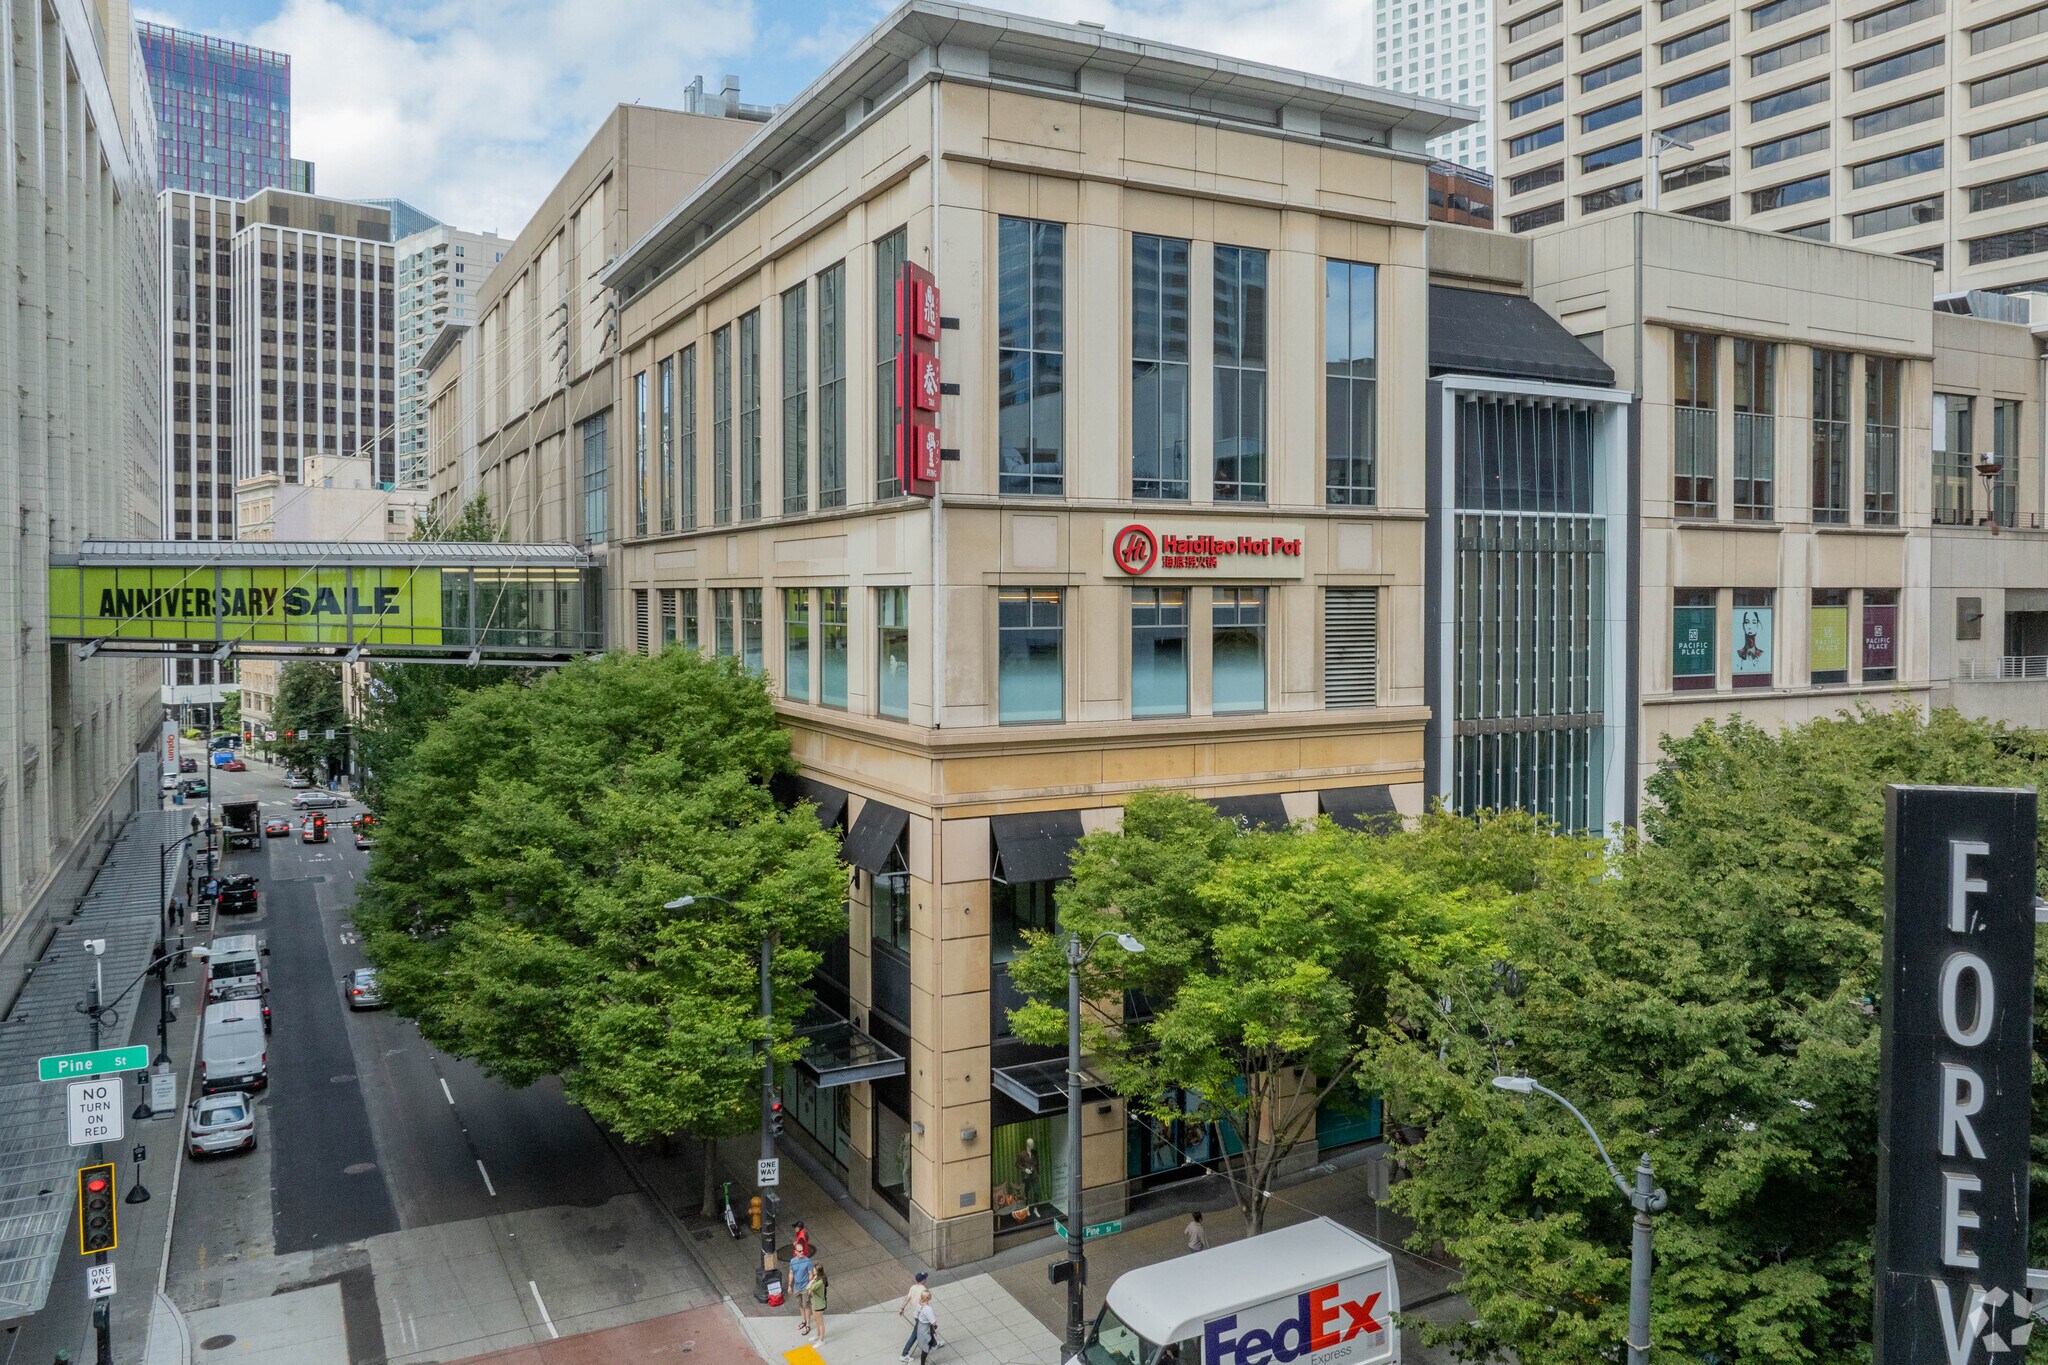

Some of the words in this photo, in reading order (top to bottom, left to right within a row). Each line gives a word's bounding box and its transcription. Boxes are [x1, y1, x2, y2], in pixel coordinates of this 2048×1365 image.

[1162, 534, 1237, 556] Haidilao
[1238, 536, 1270, 556] Hot
[1272, 537, 1302, 557] Pot
[99, 586, 279, 618] ANNIVERSARY
[283, 586, 401, 617] SALE
[166, 734, 175, 762] Optum
[58, 1059, 93, 1073] Pine
[114, 1056, 127, 1066] St
[83, 1087, 107, 1101] NO
[80, 1101, 111, 1113] TURN
[87, 1114, 104, 1125] ON
[85, 1126, 108, 1137] RED
[760, 1160, 777, 1169] ONE
[760, 1168, 777, 1176] WAY
[1085, 1227, 1100, 1237] Pine
[91, 1266, 111, 1277] ONE
[91, 1275, 112, 1286] WAY
[1204, 1282, 1382, 1365] FedEx
[1310, 1345, 1352, 1365] Express
